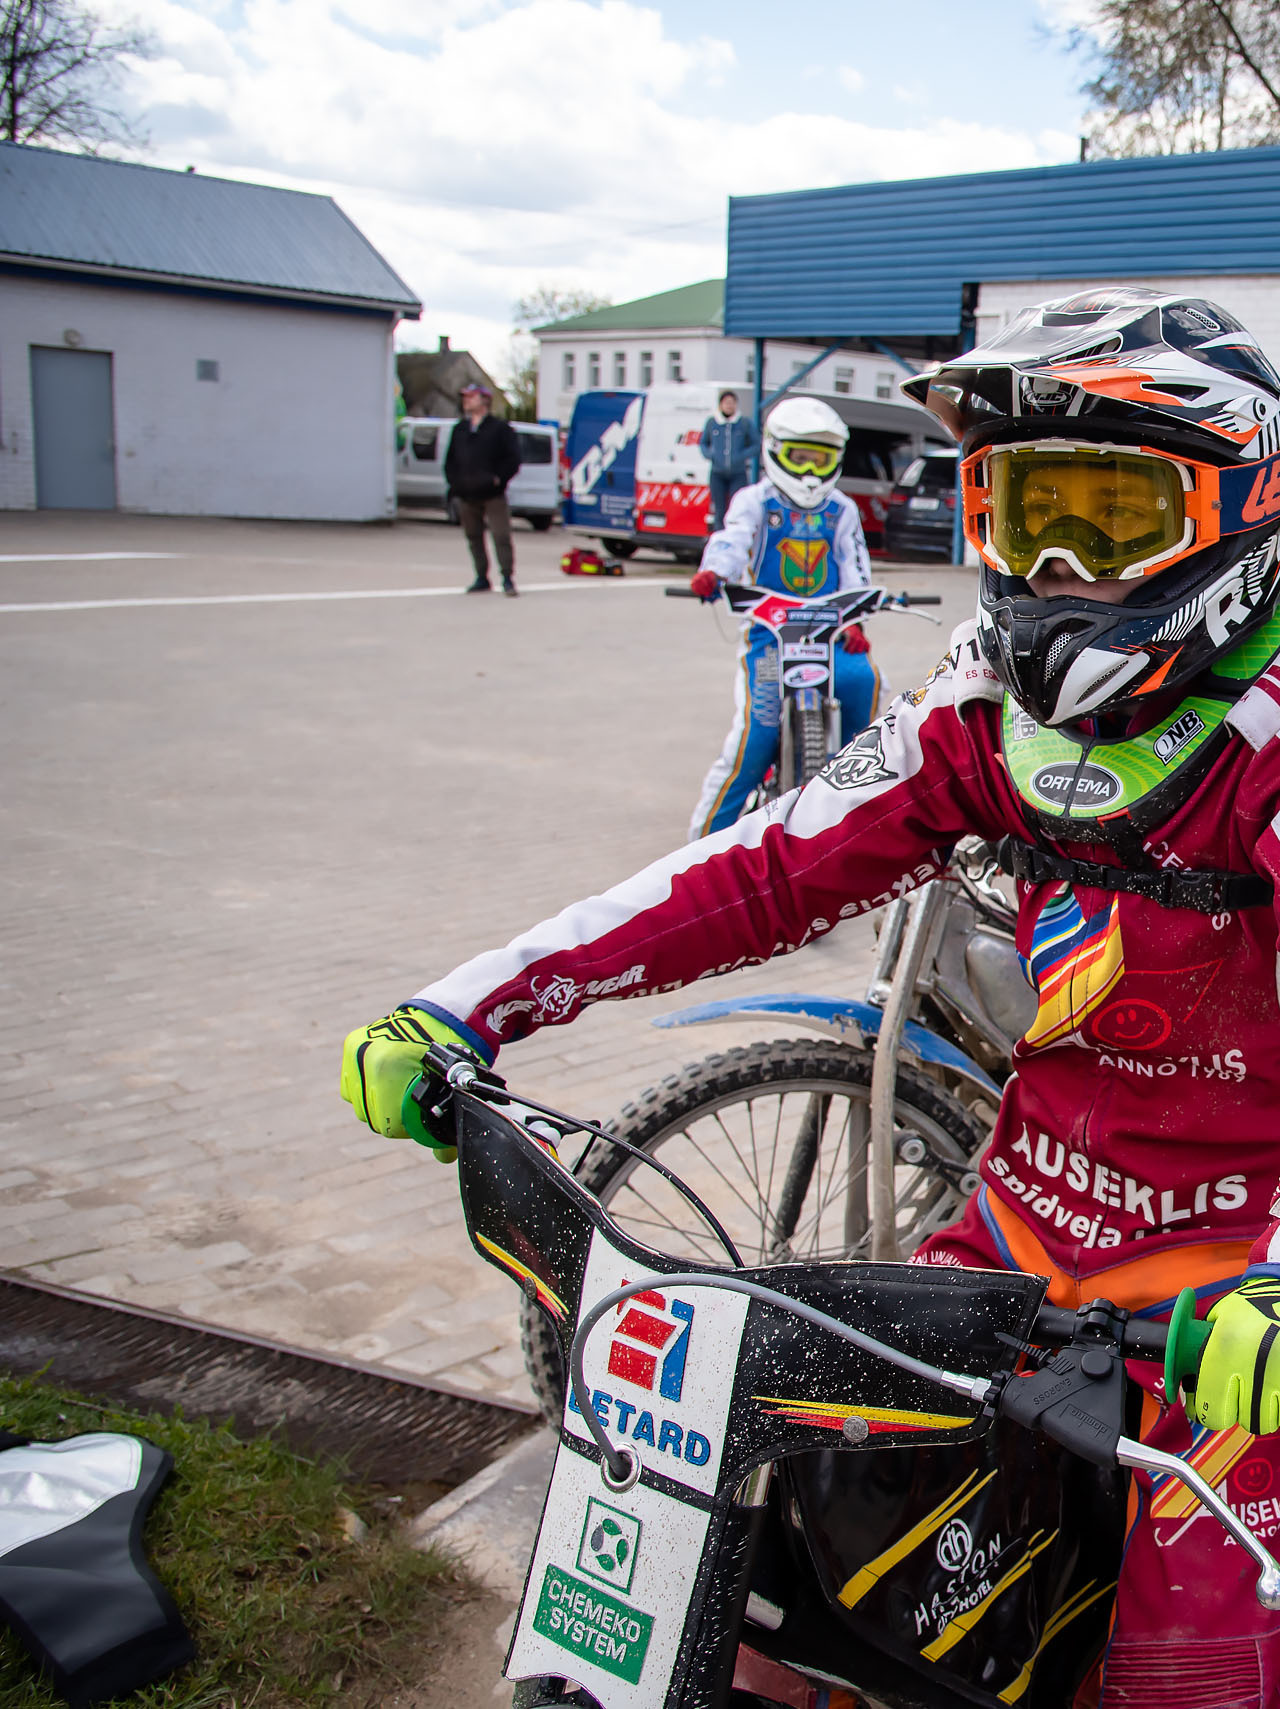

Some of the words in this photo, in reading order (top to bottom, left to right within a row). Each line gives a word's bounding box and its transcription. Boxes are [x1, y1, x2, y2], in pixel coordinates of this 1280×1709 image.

[1038, 774, 1111, 797] ORTEMA
[1099, 1054, 1177, 1078] ANNO
[1010, 1124, 1248, 1226] AUSEKLIS
[547, 1579, 641, 1643] CHEMEKO
[959, 1580, 994, 1612] HOTEL
[549, 1606, 627, 1664] SYSTEM
